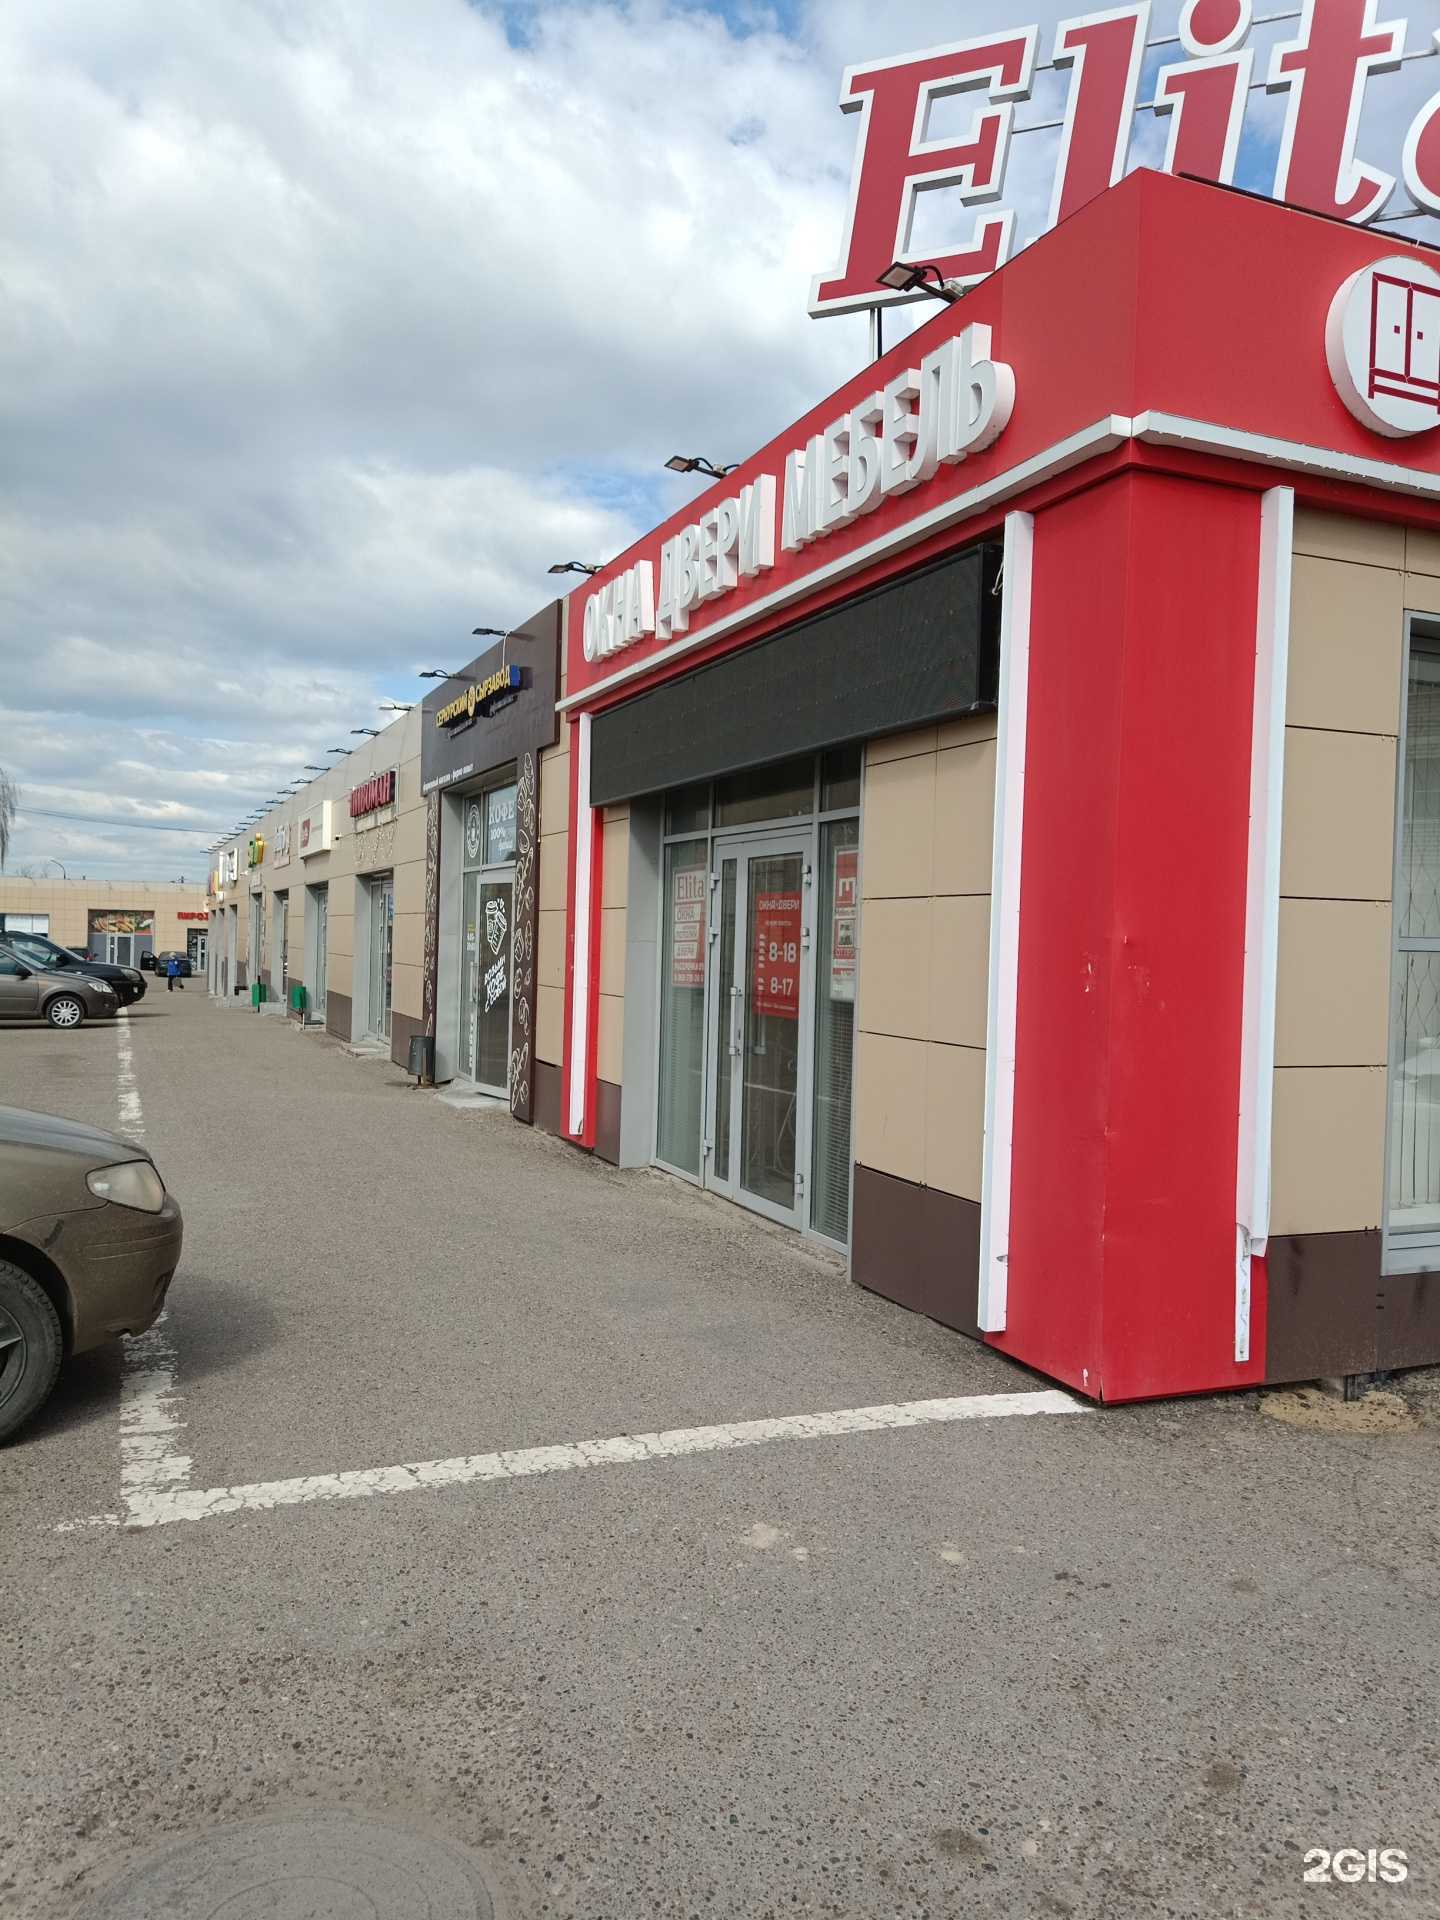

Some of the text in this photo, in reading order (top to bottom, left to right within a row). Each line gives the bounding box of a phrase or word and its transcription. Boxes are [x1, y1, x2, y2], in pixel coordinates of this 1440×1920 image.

[583, 322, 1016, 662] ОКНА ДВЕРИ МЕБЕЛЬ
[475, 664, 511, 702] СЫРЗАВОД
[489, 800, 515, 825] КОФЕ
[676, 873, 704, 900] Elita
[769, 942, 797, 963] 8-18
[770, 976, 794, 996] 8-17
